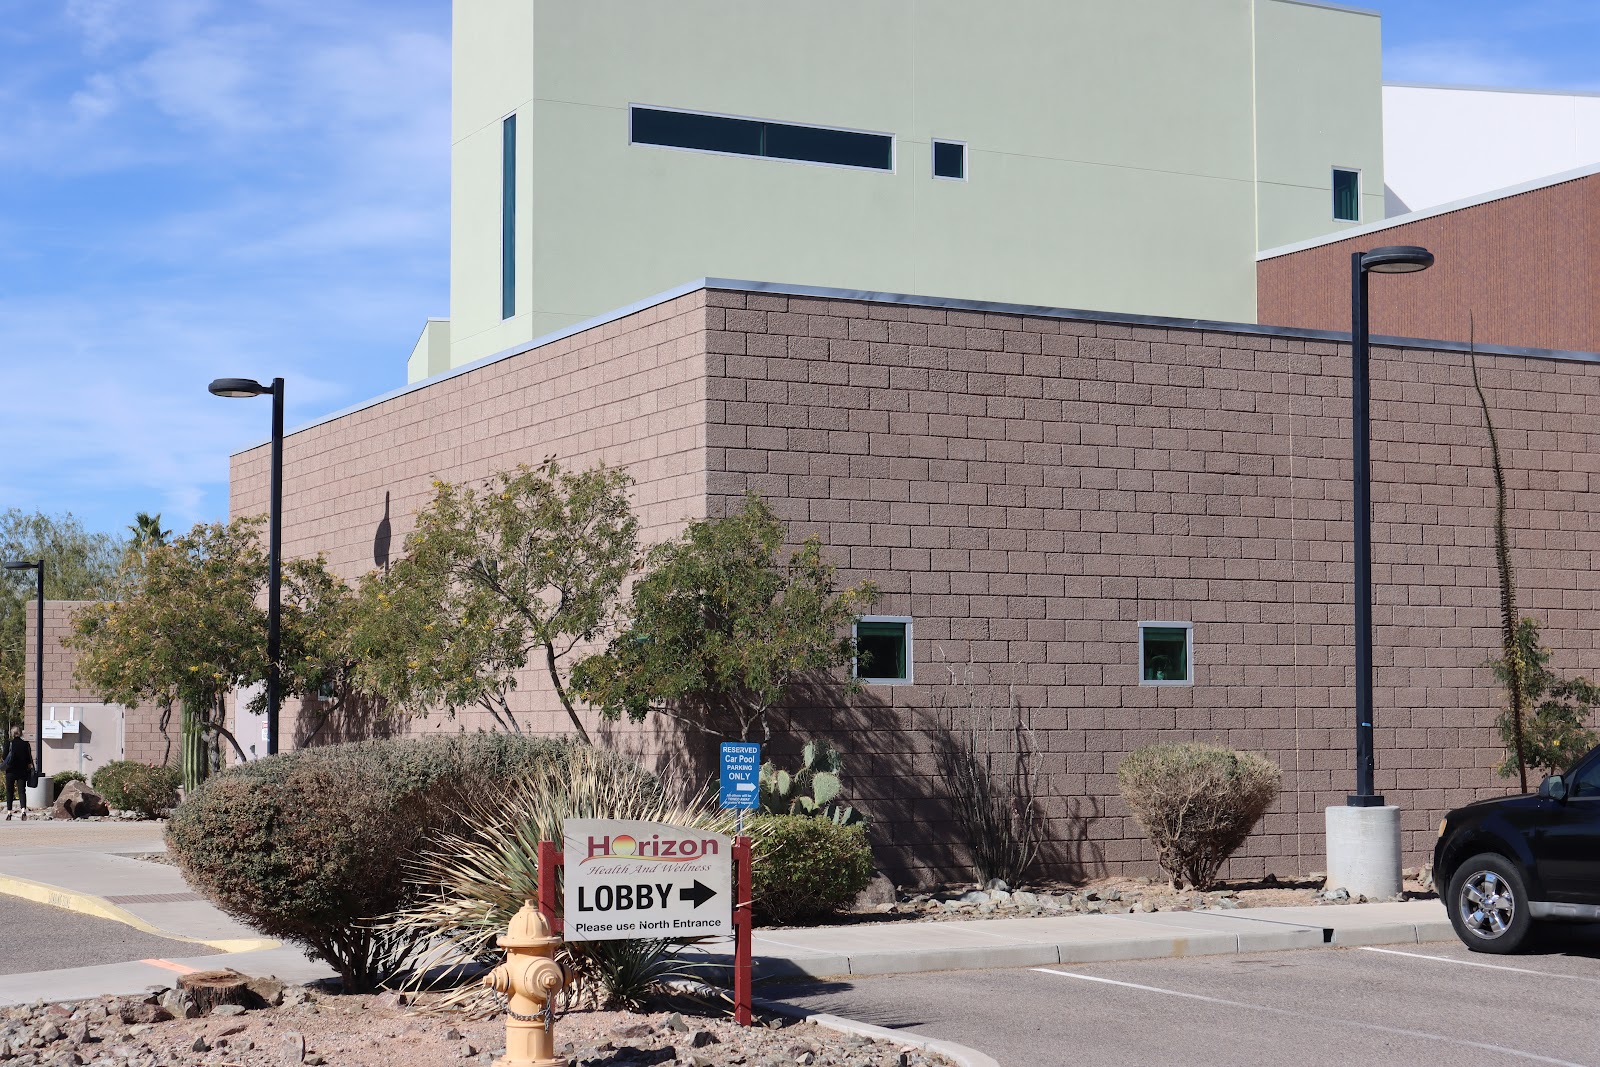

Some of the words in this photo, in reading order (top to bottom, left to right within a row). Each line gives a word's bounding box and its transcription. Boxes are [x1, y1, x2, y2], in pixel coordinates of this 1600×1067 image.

[725, 755, 737, 763] Car
[739, 755, 755, 763] Pool
[728, 772, 751, 780] ONLY
[588, 834, 719, 858] Horizon
[587, 863, 629, 875] Health
[629, 863, 657, 875] And
[661, 862, 712, 873] Wellness
[578, 883, 674, 912] LOBBY
[576, 923, 613, 932] Please
[616, 923, 636, 931] use
[639, 920, 670, 930] North
[673, 919, 722, 929] Entrance
